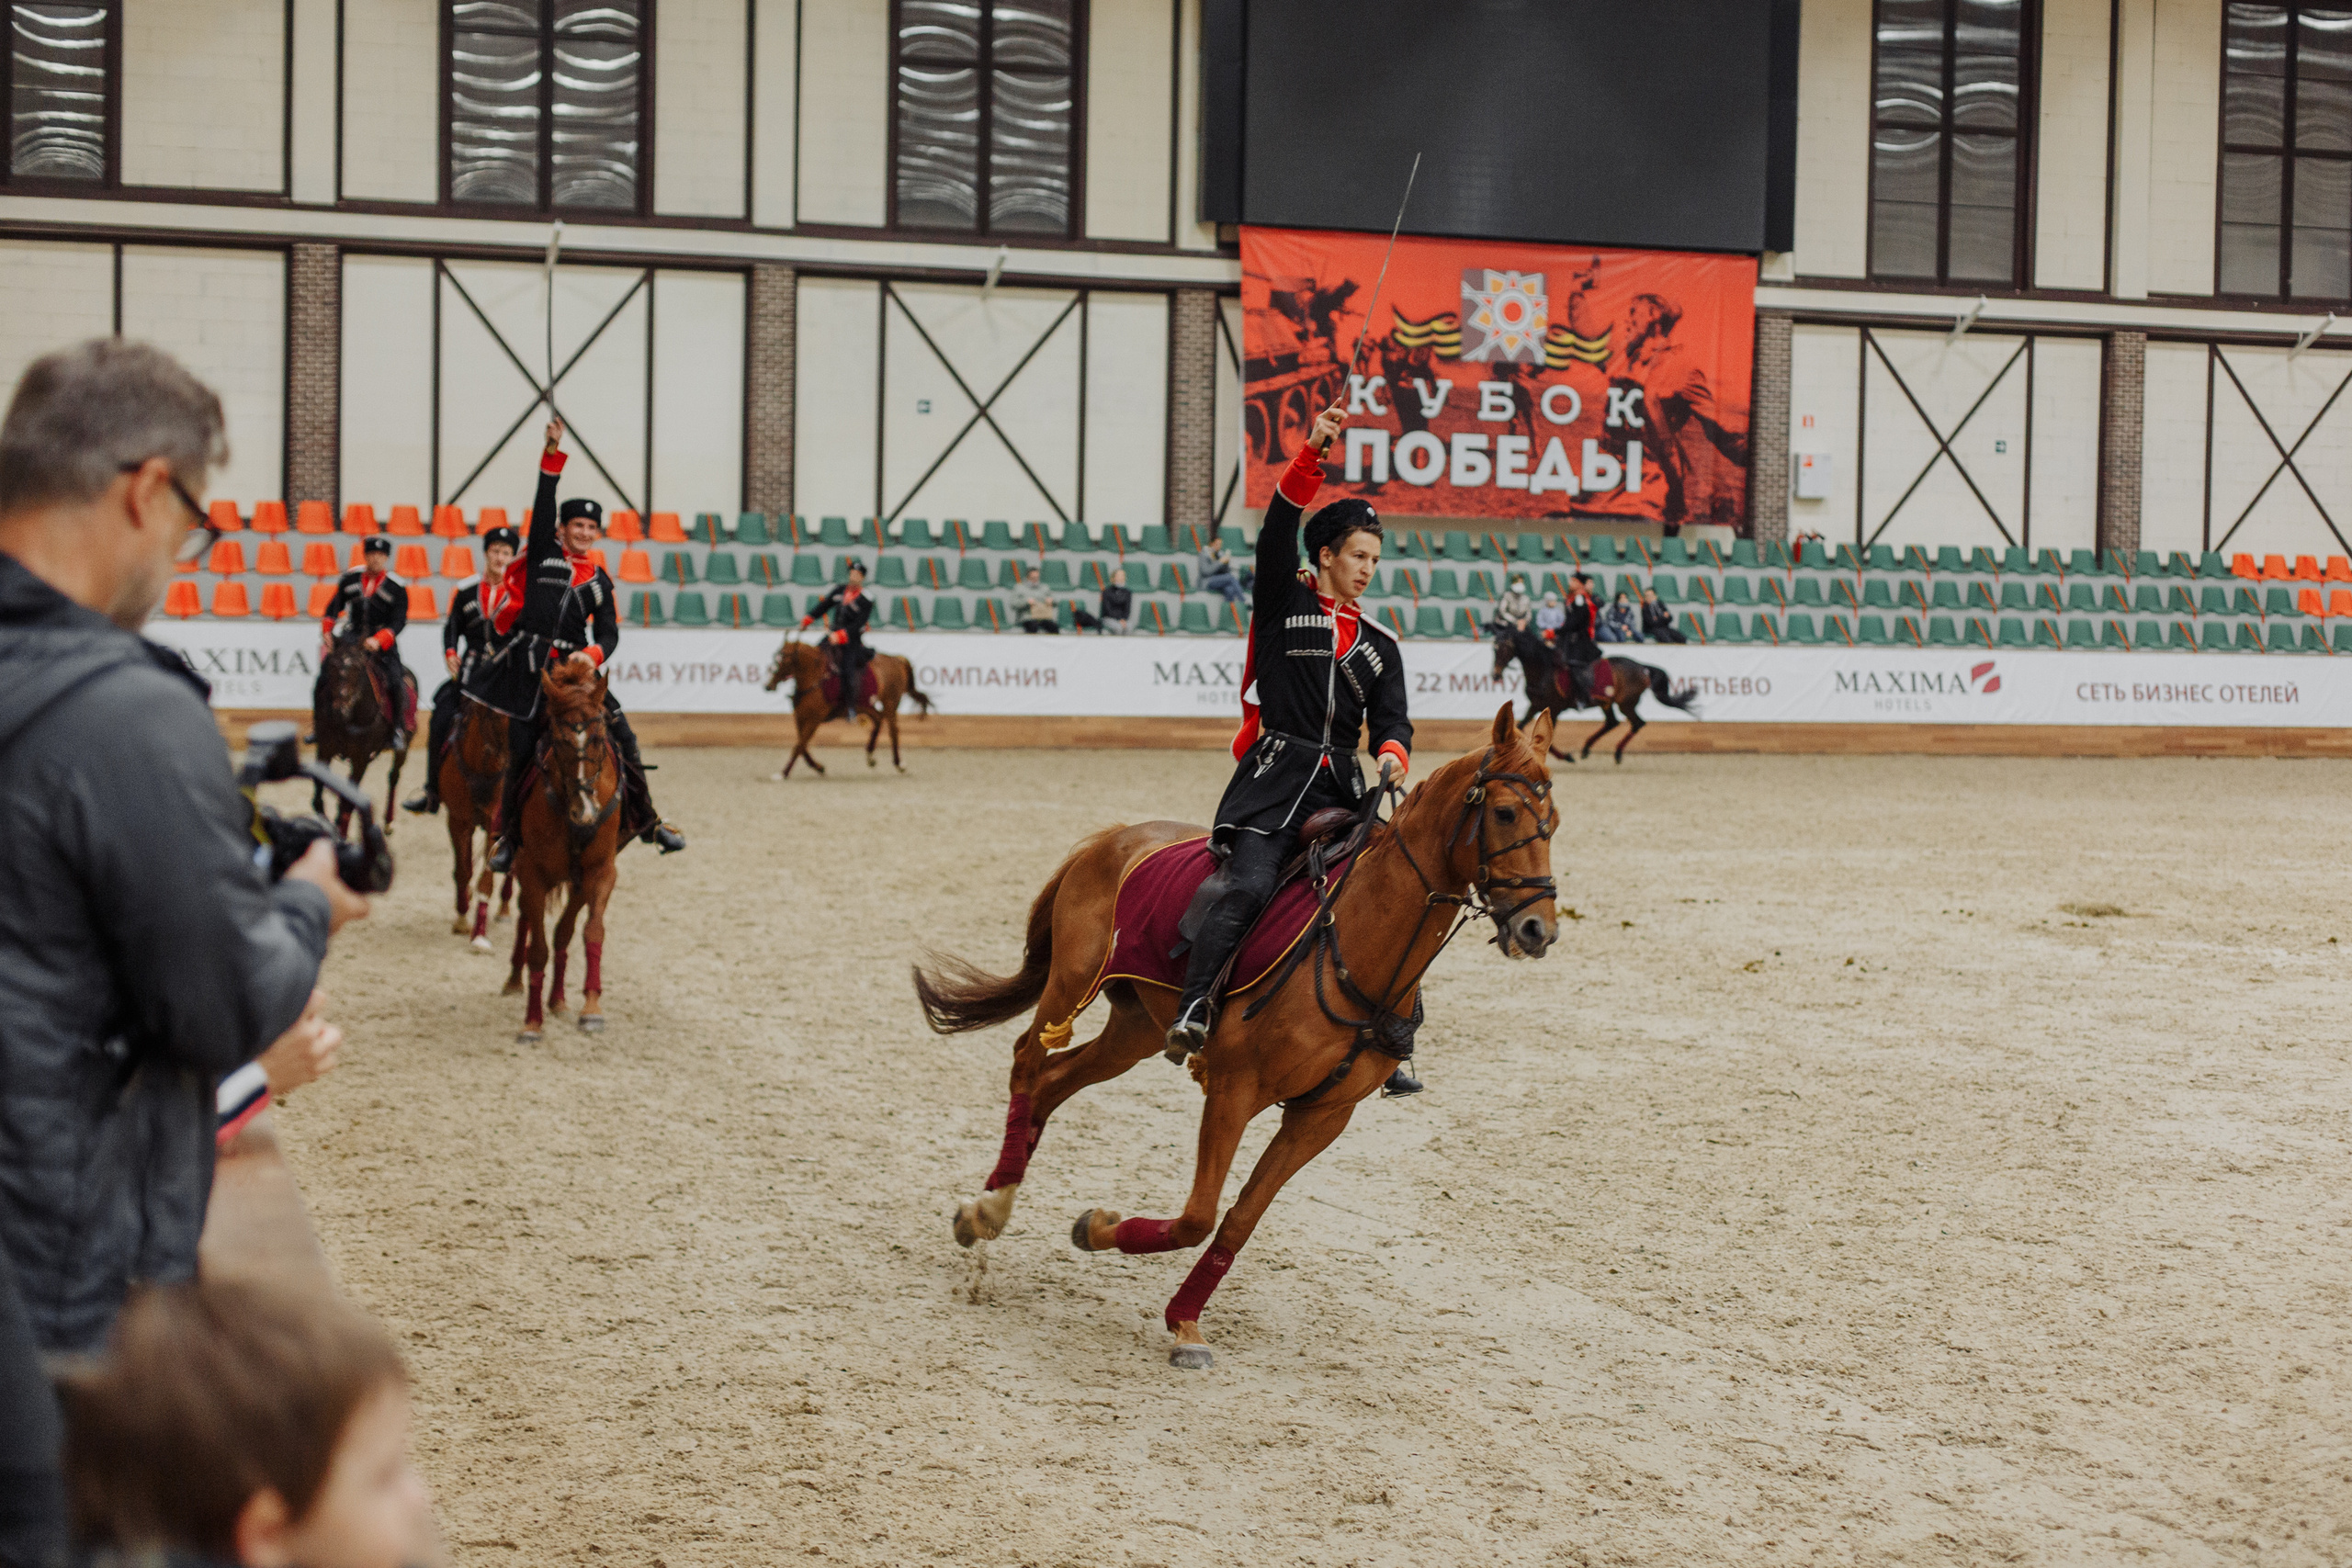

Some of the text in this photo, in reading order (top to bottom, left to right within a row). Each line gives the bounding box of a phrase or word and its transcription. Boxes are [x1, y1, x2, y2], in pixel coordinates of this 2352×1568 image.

[1347, 374, 1645, 428] КУБОК
[1344, 427, 1643, 495] ПОБЕДЫ
[180, 647, 311, 675] AXIMA
[1152, 660, 1245, 685] MAXI
[608, 662, 1057, 687] НАЯ УПРАВ ОМПАНИЯ
[1416, 672, 1771, 696] 22 МИНУ МЕТЬЕВО
[1835, 670, 1968, 694] MAXIMA
[212, 679, 263, 695] TELS
[1196, 691, 1240, 705] HOTE
[2075, 680, 2300, 704] СЕТЬ БИЗНЕС ОТЕЛЕЙ
[1874, 697, 1933, 712] HOTELS
